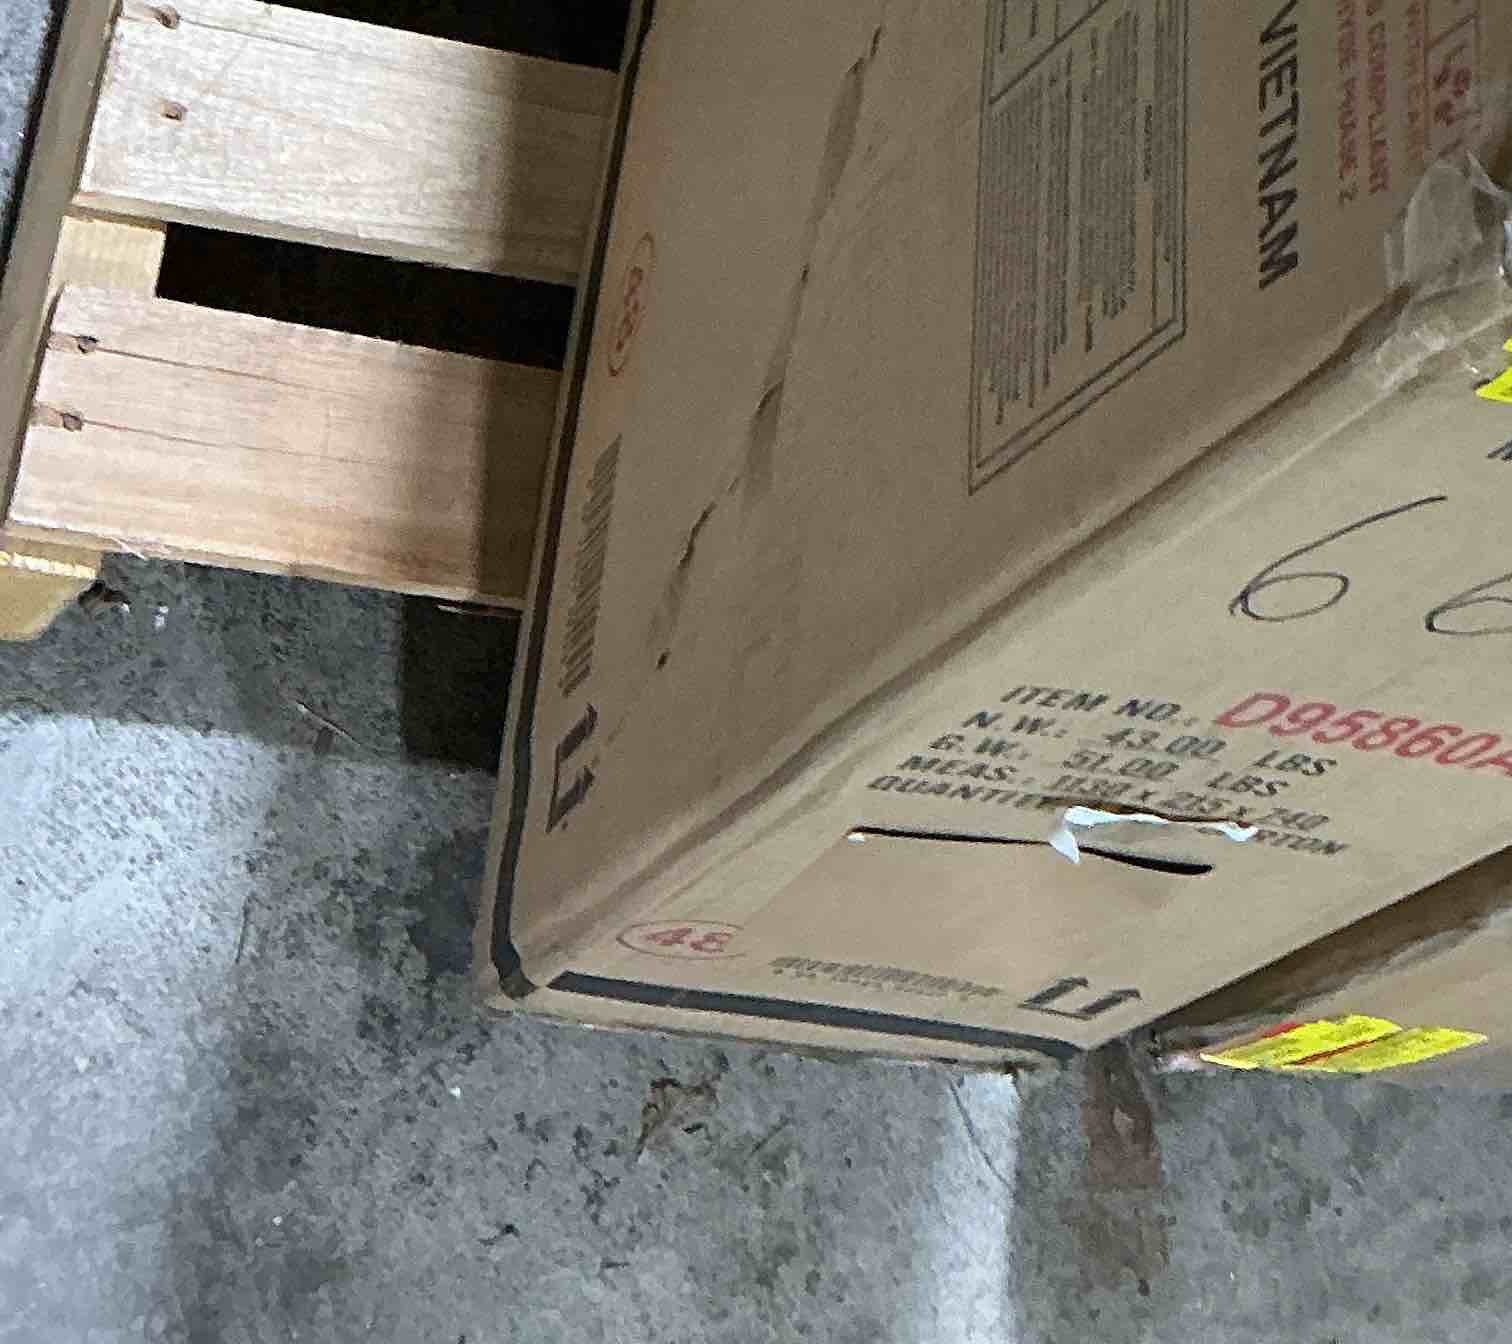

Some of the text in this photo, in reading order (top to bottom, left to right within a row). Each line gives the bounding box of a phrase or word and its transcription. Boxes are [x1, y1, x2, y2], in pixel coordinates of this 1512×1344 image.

[1000, 684, 1108, 712] ITEM
[1252, 750, 1338, 776] LBS
[1206, 771, 1290, 797] LBS
